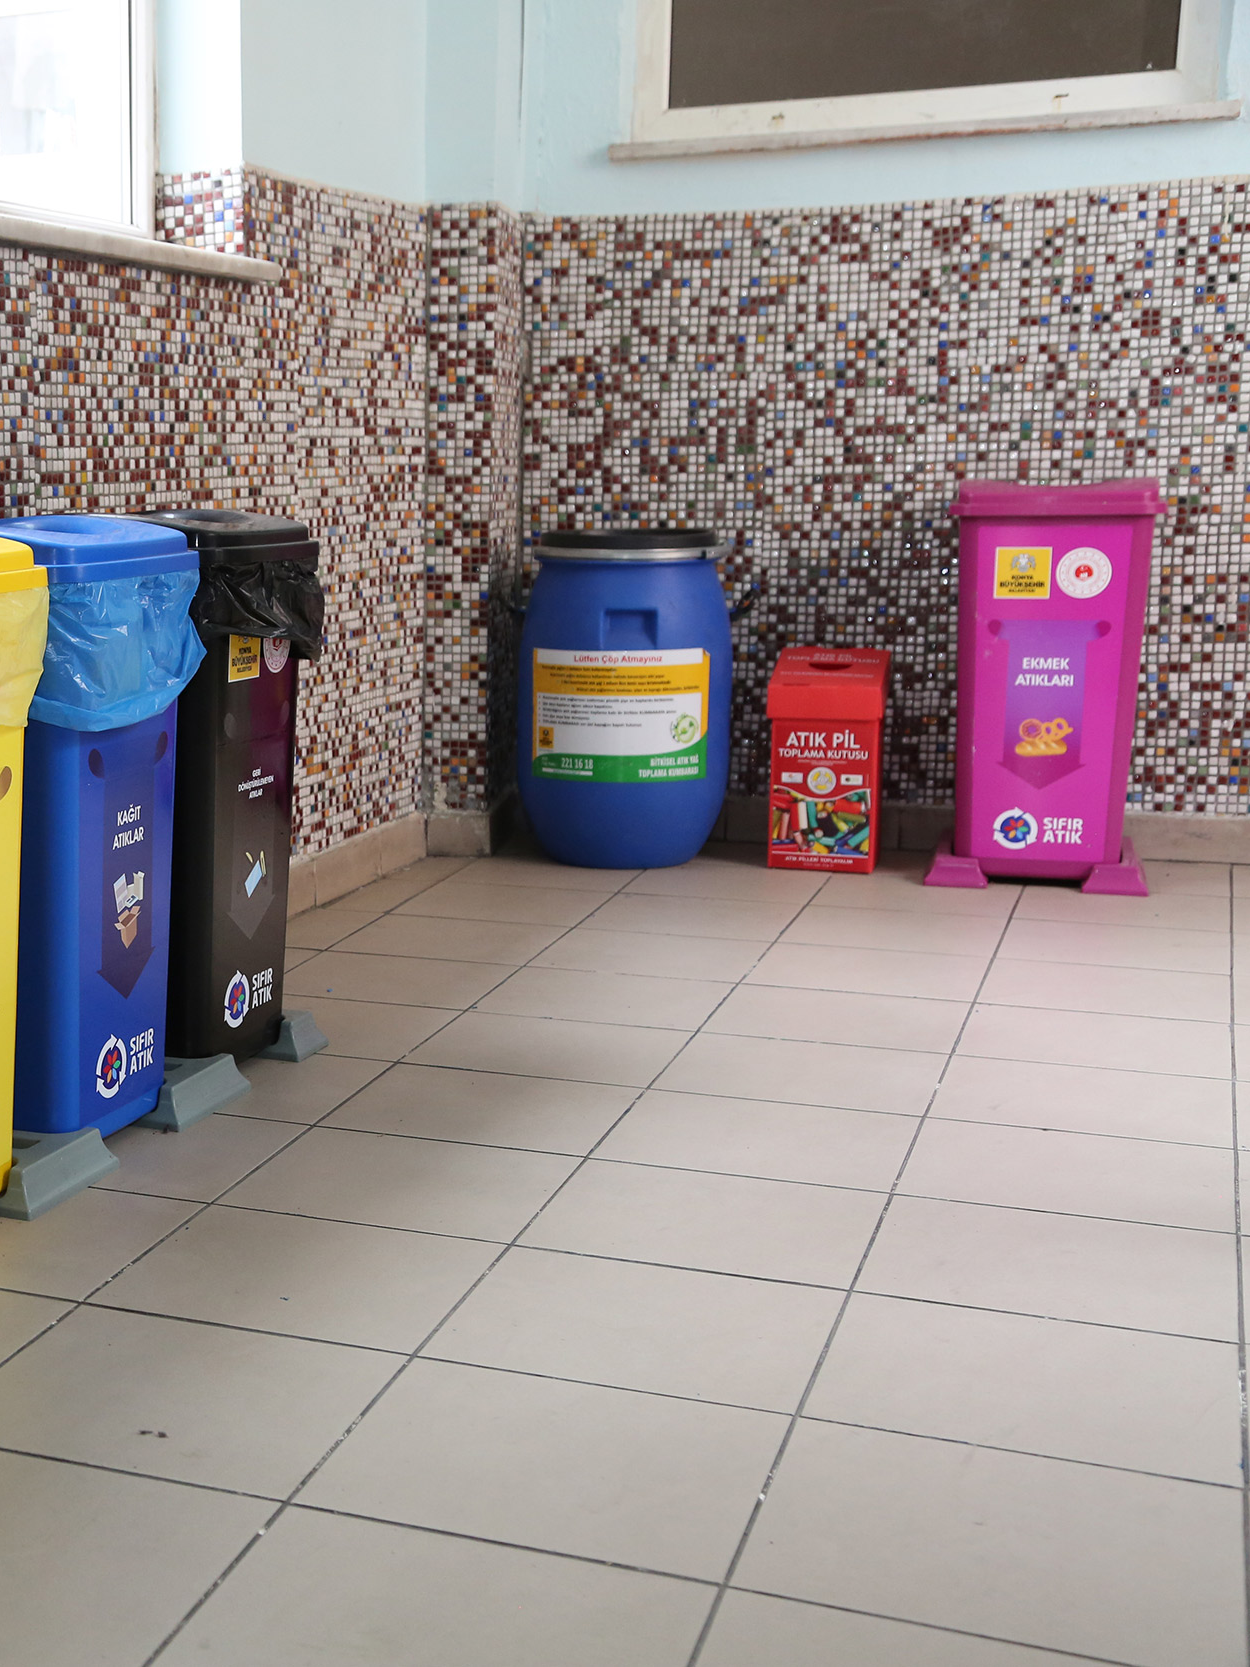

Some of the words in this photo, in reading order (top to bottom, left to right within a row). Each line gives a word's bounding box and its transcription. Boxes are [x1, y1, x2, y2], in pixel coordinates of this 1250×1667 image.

[573, 654, 599, 663] Lütfen
[601, 654, 619, 665] Çöp
[621, 655, 663, 665] Atmayınız
[1022, 657, 1070, 670] EKMEK
[1014, 673, 1074, 687] ATIKLARI
[786, 731, 827, 748] ATIK
[832, 729, 861, 749] PİL
[778, 747, 825, 758] TOPLAMA
[827, 749, 869, 760] KUTUSU
[561, 757, 573, 769] 221
[575, 758, 584, 769] 16
[585, 758, 594, 770] 18
[650, 756, 676, 767] BİTKİSEL
[677, 756, 689, 766] ATIK
[638, 768, 668, 778] TOPLAMA
[117, 803, 142, 827] KAĞIT
[1043, 816, 1083, 830] SIFIR
[112, 826, 145, 850] ATIKLAR
[1042, 830, 1083, 844] ATIK
[252, 967, 273, 991] SIFIR
[251, 983, 273, 1009] ATIK
[129, 1027, 154, 1056] SIFIR
[129, 1045, 154, 1075] ATIK
